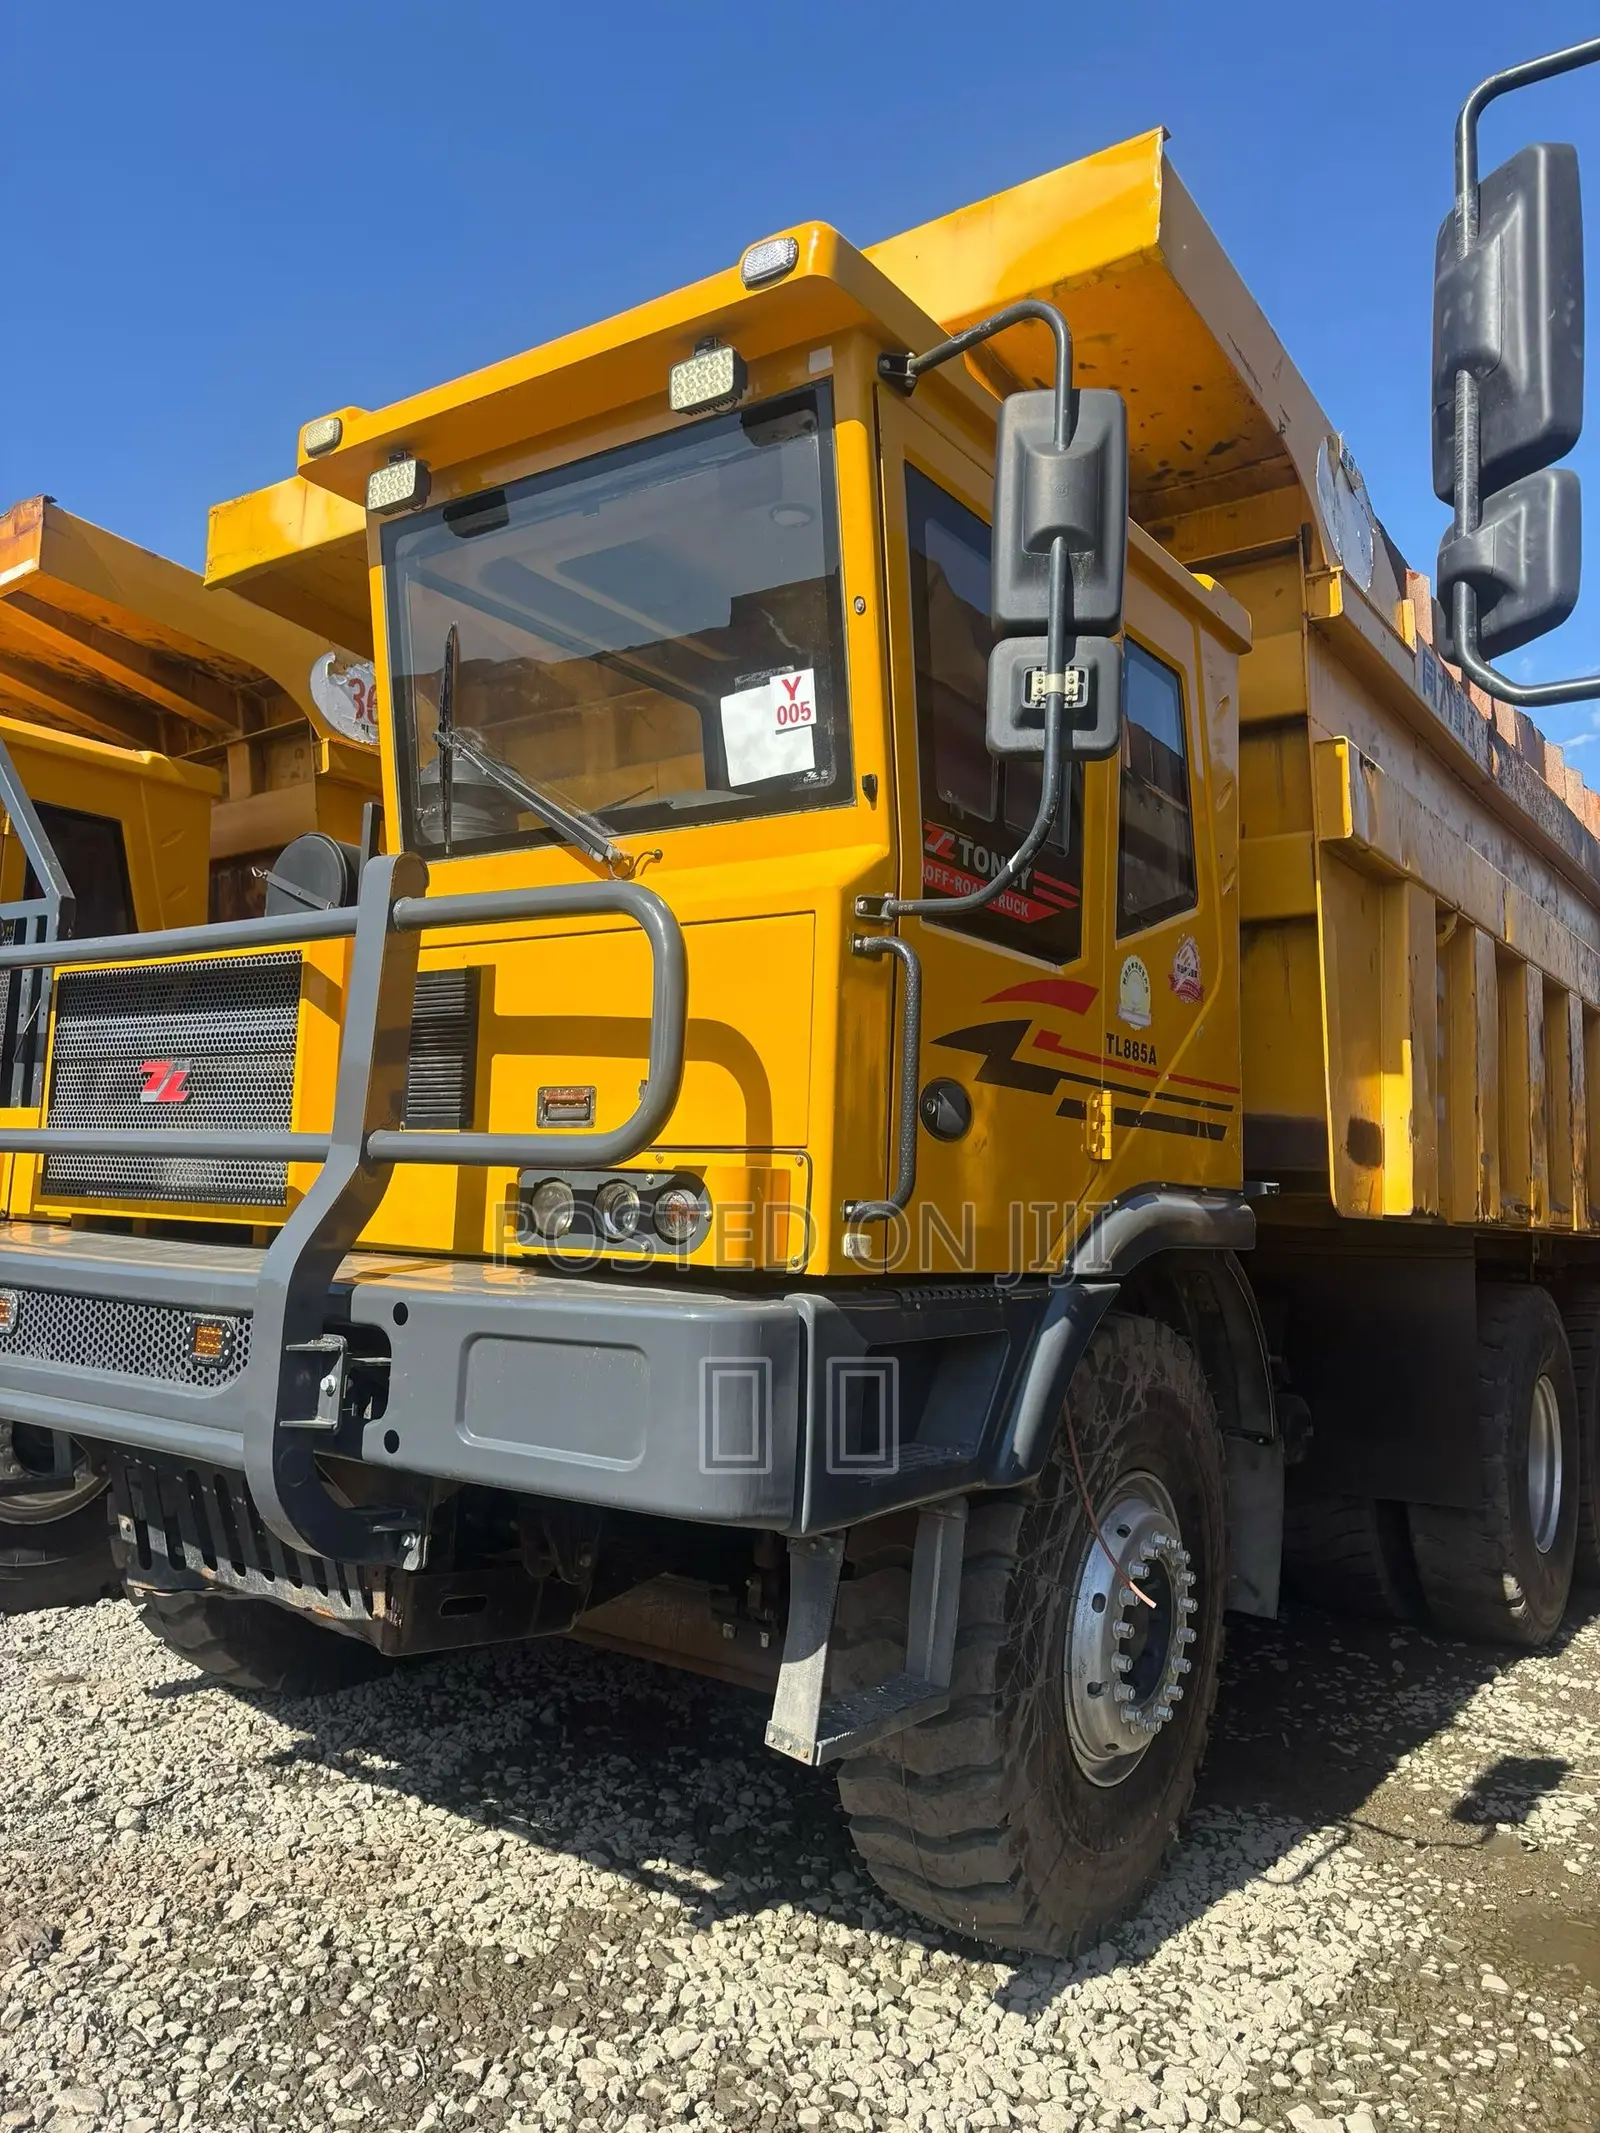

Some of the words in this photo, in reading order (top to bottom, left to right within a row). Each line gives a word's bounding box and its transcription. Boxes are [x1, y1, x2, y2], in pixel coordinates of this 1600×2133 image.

[781, 675, 802, 701] Y
[776, 700, 812, 725] 005
[958, 838, 1032, 890] TONY
[991, 893, 1029, 918] RUCK
[1105, 1032, 1157, 1066] TL885A
